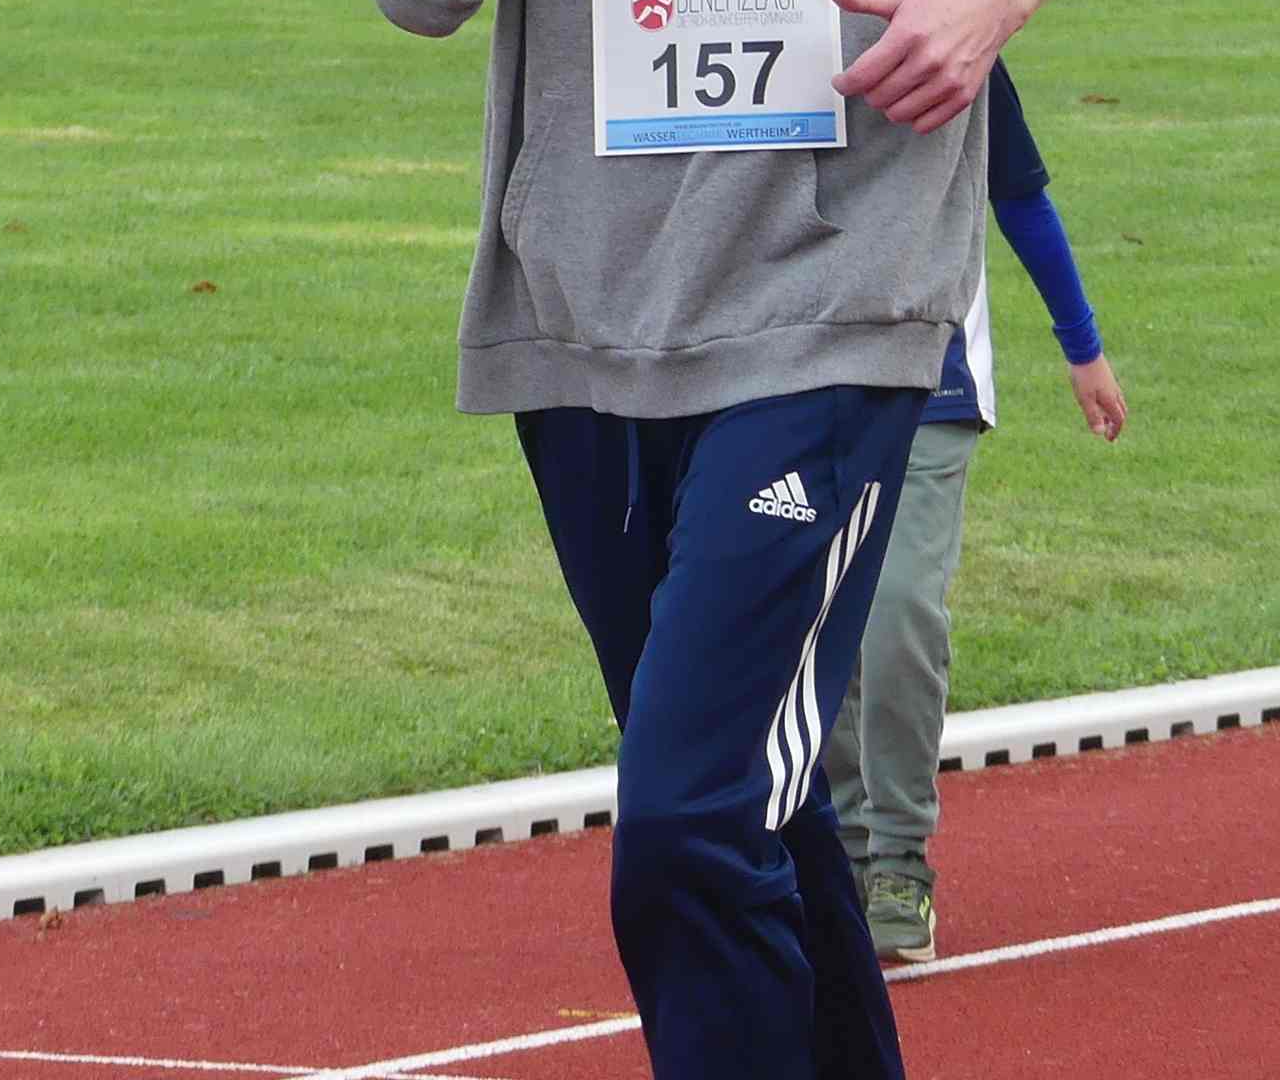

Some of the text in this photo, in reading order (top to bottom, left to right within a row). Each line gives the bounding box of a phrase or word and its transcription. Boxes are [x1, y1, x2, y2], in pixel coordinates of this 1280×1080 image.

[652, 40, 784, 109] 157
[726, 127, 790, 140] WERTHEIM
[748, 497, 818, 523] adidas
